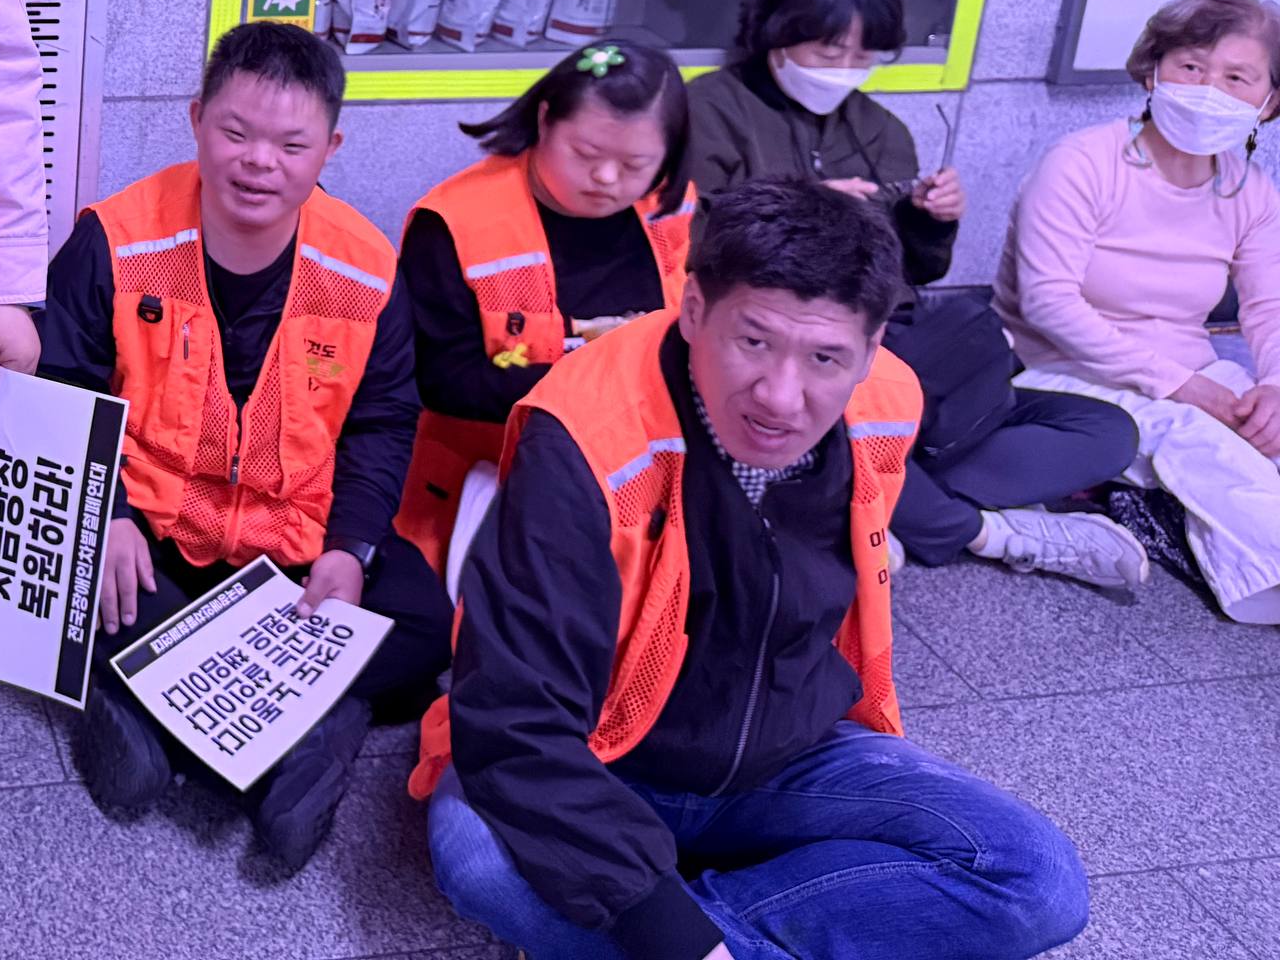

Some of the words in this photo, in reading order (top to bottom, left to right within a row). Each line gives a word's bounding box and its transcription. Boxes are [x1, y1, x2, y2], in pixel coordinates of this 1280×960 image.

[304, 338, 336, 358] 것도
[18, 456, 75, 620] 복원하라!
[67, 461, 107, 642] 전국장애인차별철폐연대
[264, 617, 329, 668] 해고는
[290, 624, 355, 686] 이것도
[161, 646, 250, 713] 책임이다
[185, 662, 273, 735] 살인이다
[210, 681, 302, 756] 노동이다
